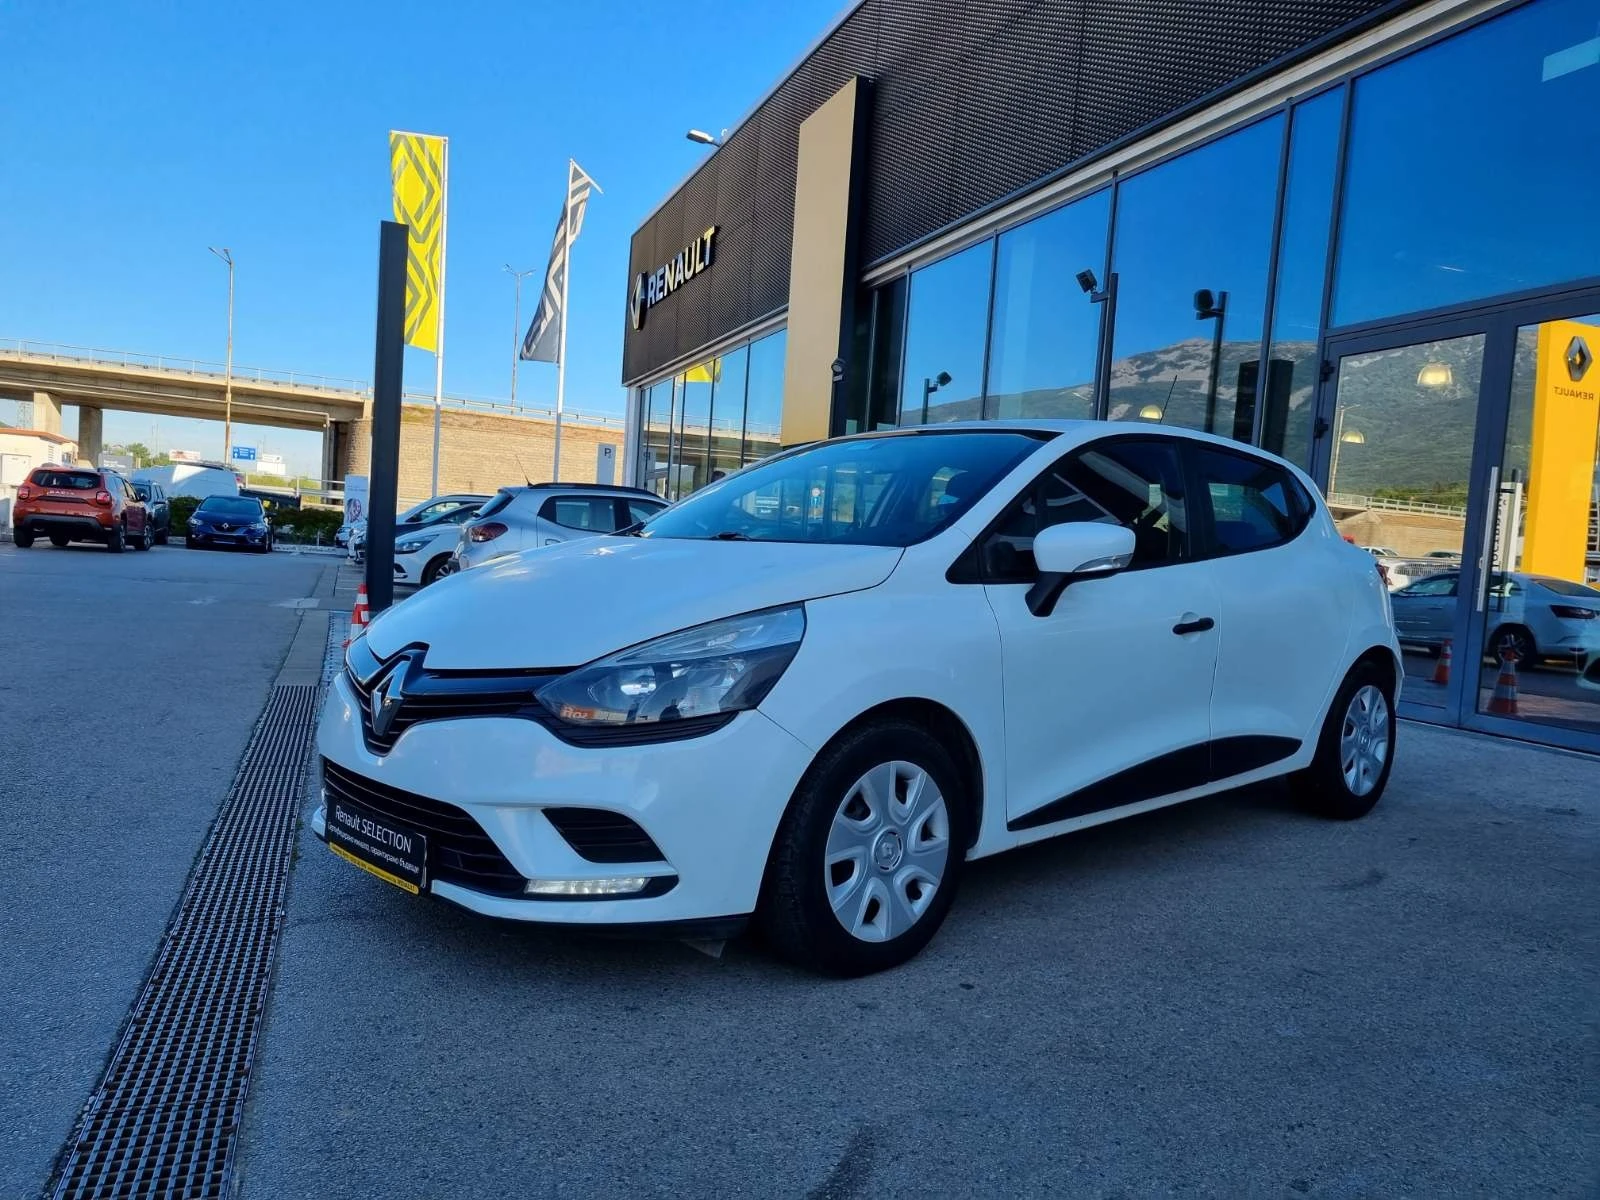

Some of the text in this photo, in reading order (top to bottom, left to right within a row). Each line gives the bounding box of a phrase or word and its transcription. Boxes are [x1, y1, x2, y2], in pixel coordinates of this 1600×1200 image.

[647, 225, 715, 308] RENAULT
[604, 447, 612, 456] P
[336, 805, 411, 853] Renault SELECTION
